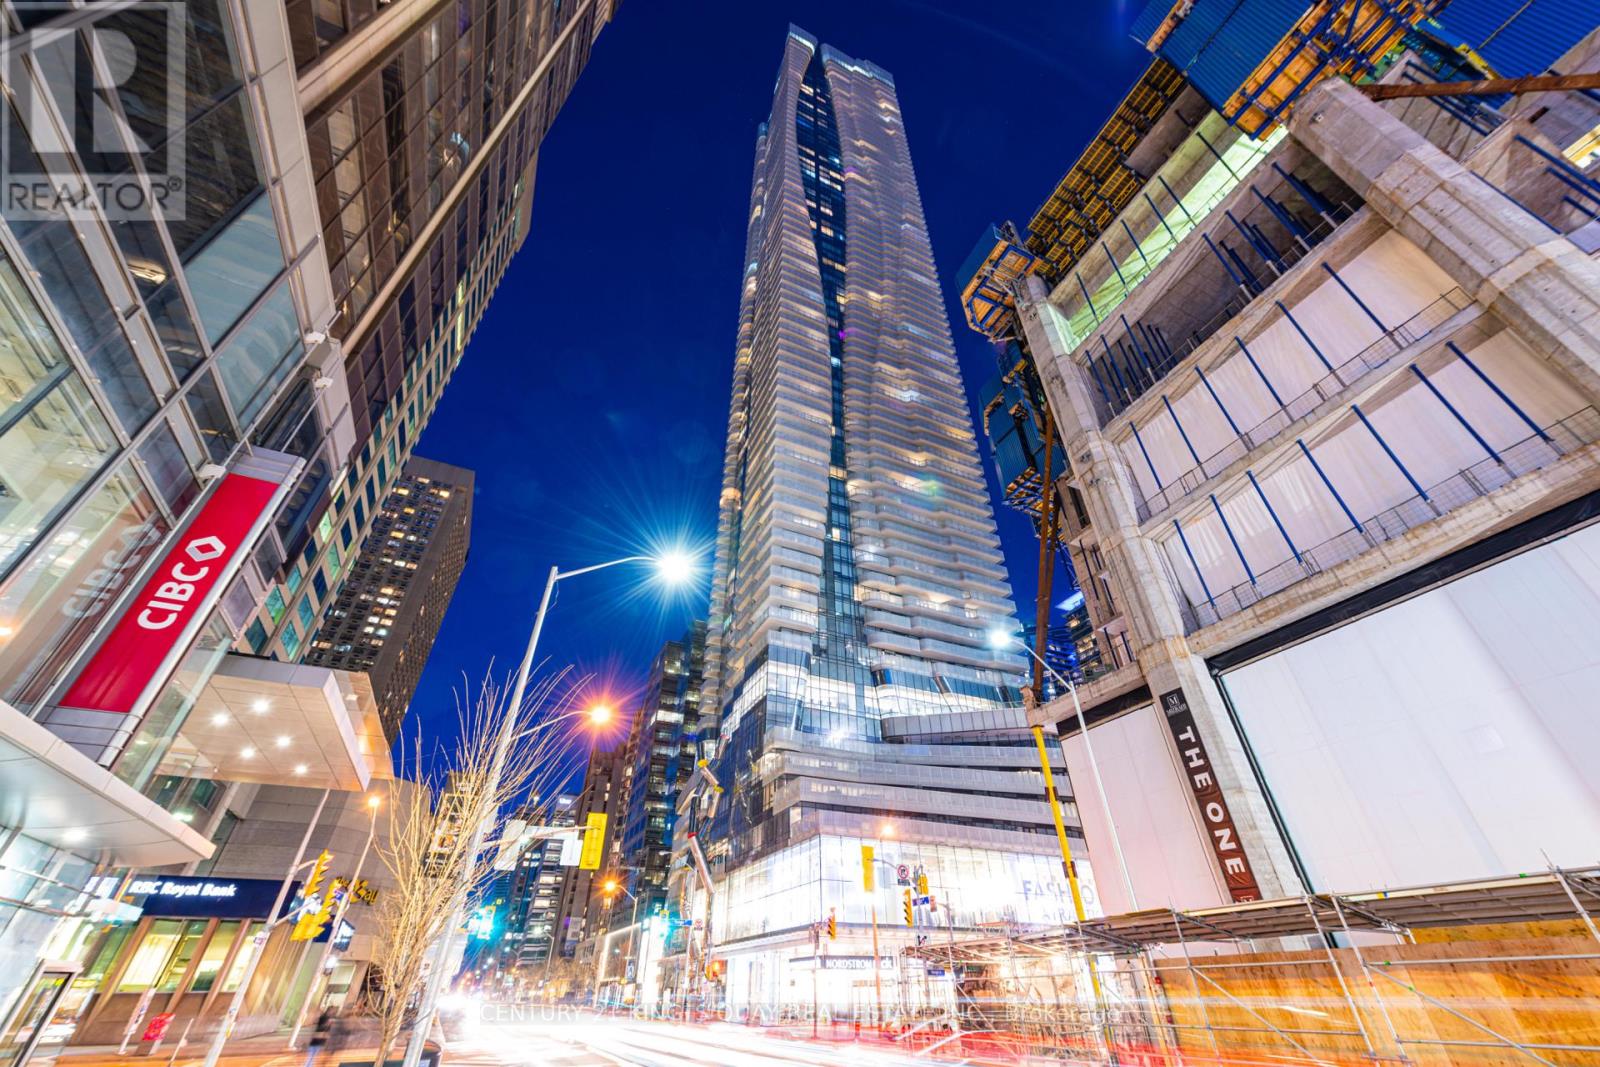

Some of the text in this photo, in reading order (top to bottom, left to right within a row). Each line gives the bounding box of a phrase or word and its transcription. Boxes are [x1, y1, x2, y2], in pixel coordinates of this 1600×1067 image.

[137, 562, 209, 630] CIBC
[1179, 726, 1245, 875] THE ONE
[160, 881, 203, 898] Royal
[200, 883, 238, 897] Bank
